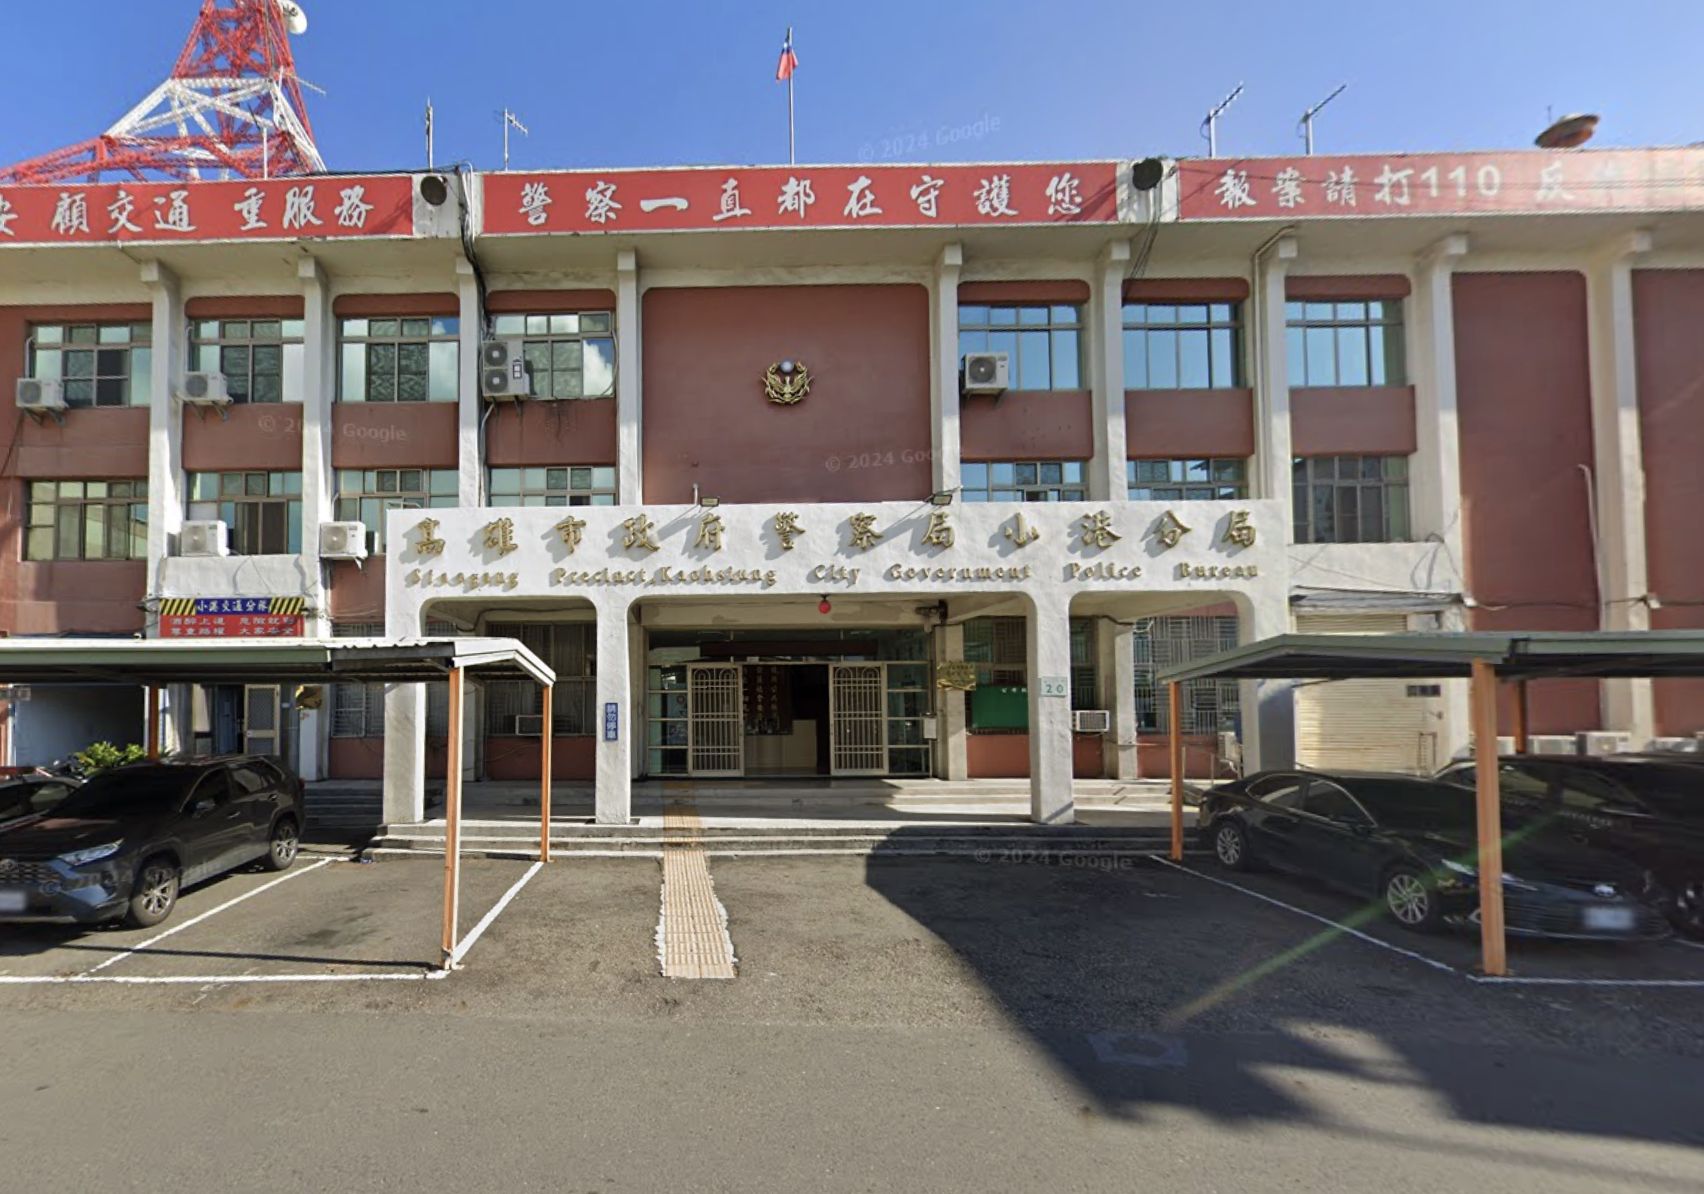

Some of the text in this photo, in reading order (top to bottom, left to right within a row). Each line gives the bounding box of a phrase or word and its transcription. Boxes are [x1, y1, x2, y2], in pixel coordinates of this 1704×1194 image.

[51, 190, 197, 236] 顧交通
[233, 185, 375, 231] 重服務
[518, 172, 1083, 226] 警察一直都在守護您
[414, 509, 1257, 555] 高雄市政府警察局小港分局
[814, 564, 862, 586] City
[889, 563, 1032, 580] Government
[1070, 562, 1143, 580] Police
[1180, 562, 1260, 579] Bureau
[1045, 684, 1064, 694] 20
